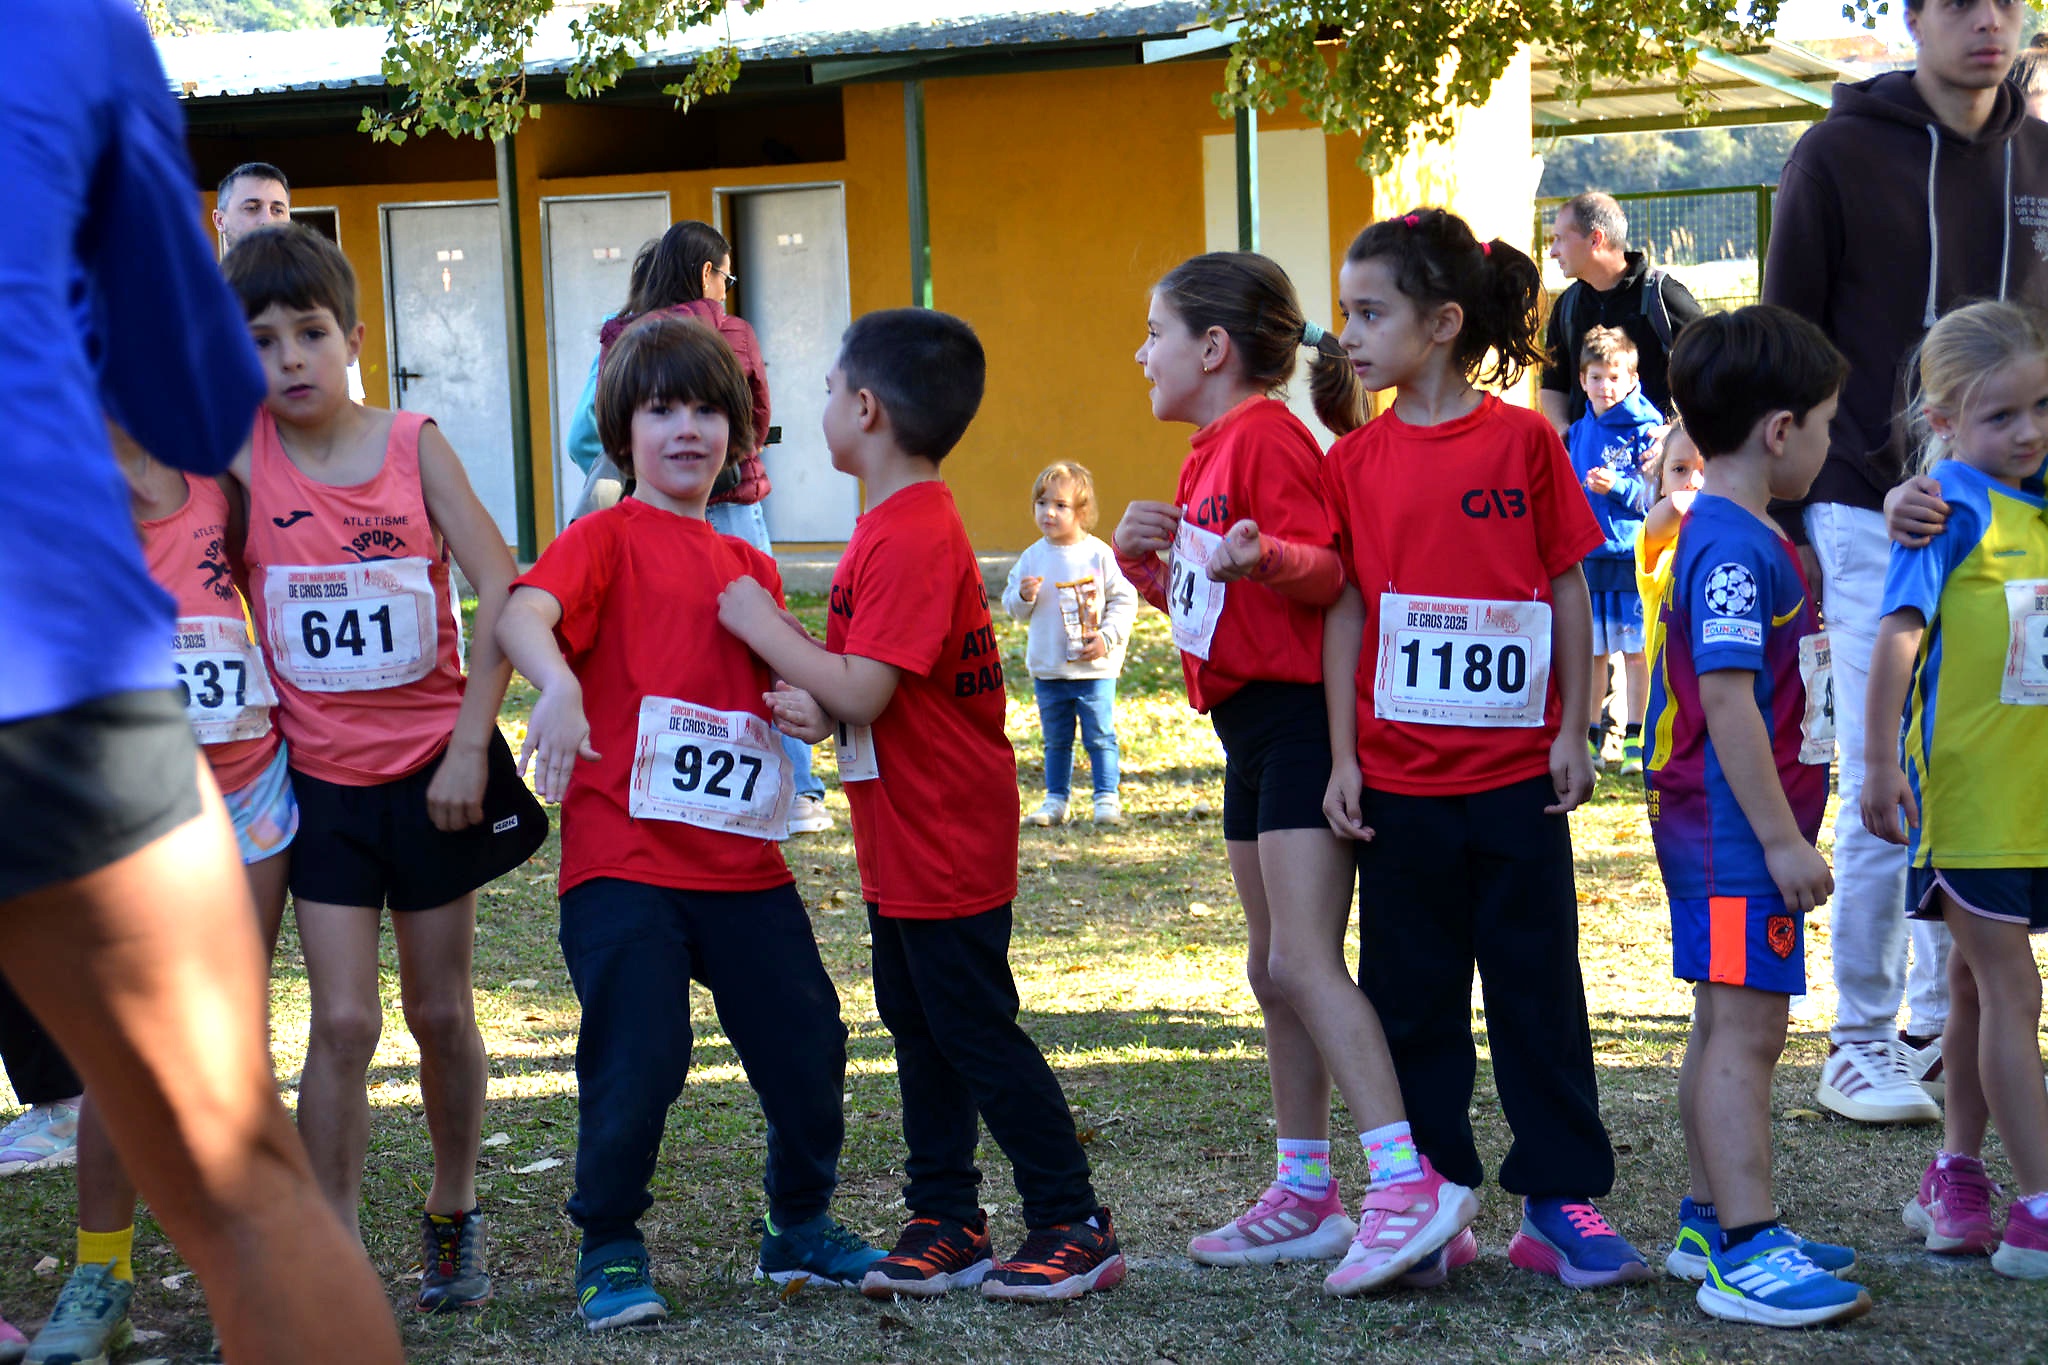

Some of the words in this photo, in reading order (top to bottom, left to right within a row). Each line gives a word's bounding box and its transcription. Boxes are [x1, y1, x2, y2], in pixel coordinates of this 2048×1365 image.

[343, 515, 409, 526] ATLETISME
[352, 530, 406, 552] SPORT
[288, 584, 299, 598] DE
[299, 583, 322, 598] CROS
[324, 583, 348, 597] 2025
[1408, 601, 1431, 612] CIRCUIT
[1407, 612, 1419, 627] DE
[1419, 613, 1443, 629] CROS
[1444, 615, 1468, 631] 2025
[301, 604, 394, 659] 641
[182, 634, 206, 649] 2025
[1401, 639, 1526, 693] 1180
[671, 704, 693, 717] CIRCUIT
[669, 716, 681, 731] DE
[682, 718, 706, 734] CROS
[706, 723, 729, 739] 2025
[672, 744, 762, 802] 927
